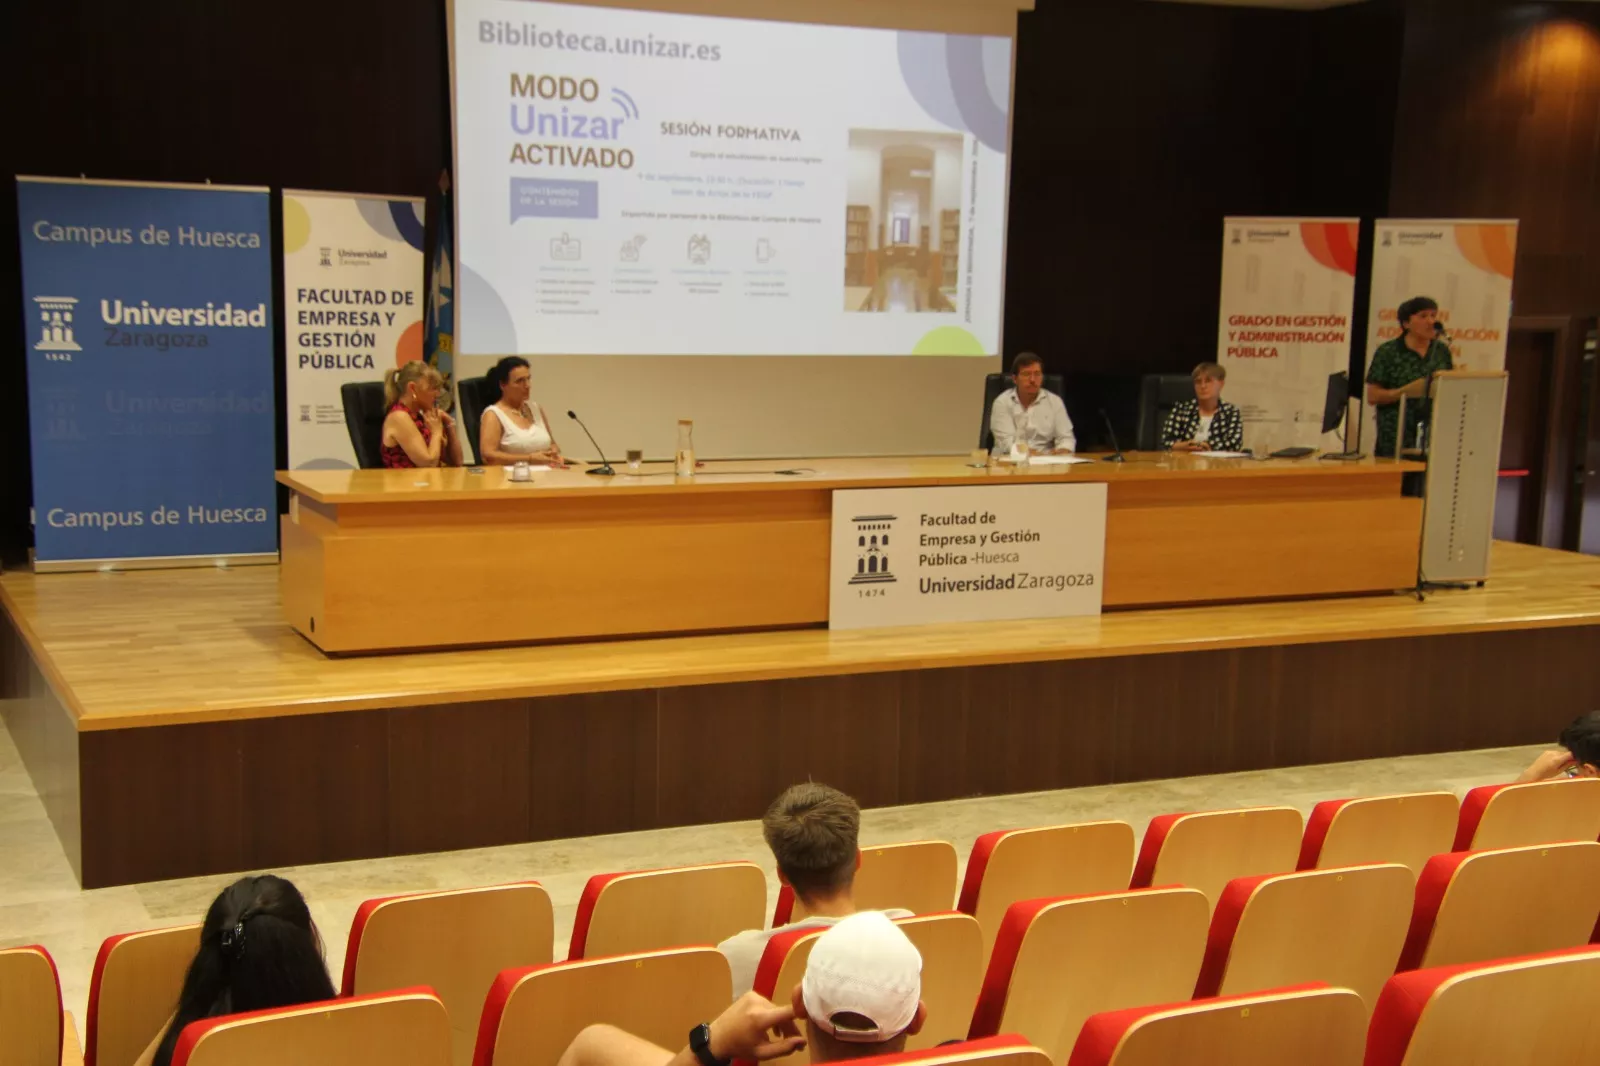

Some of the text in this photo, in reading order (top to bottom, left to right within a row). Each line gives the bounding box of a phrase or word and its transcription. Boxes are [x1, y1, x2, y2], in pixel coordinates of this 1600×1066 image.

[478, 19, 722, 61] Biblioteca.unizar.es
[510, 72, 600, 103] MODO
[510, 102, 625, 140] Unizar
[660, 120, 802, 142] SESIÓN FORMATIVA
[509, 142, 635, 170] ACTIVADO
[33, 220, 261, 249] Campus de Huesca
[297, 287, 415, 306] FACULTAD DE
[101, 299, 267, 328] Universidad
[298, 310, 396, 327] EMPRESA Y
[1228, 314, 1347, 327] GRADO EN GESTIÓN
[104, 328, 209, 352] Zaragoza
[298, 329, 376, 348] GESTIÓN
[1228, 330, 1345, 343] Y ADMINISTRACIÓN
[299, 350, 375, 369] PÚBLICA
[1227, 344, 1278, 358] PÚBLICA
[47, 504, 267, 531] Campus de Huesca
[920, 510, 997, 527] Facultad de
[920, 529, 1041, 549] Empresa y Gestión
[919, 551, 1020, 567] Pública -Huesca
[858, 587, 886, 599] 1474
[919, 571, 1095, 595] Universidad Zaragoza
